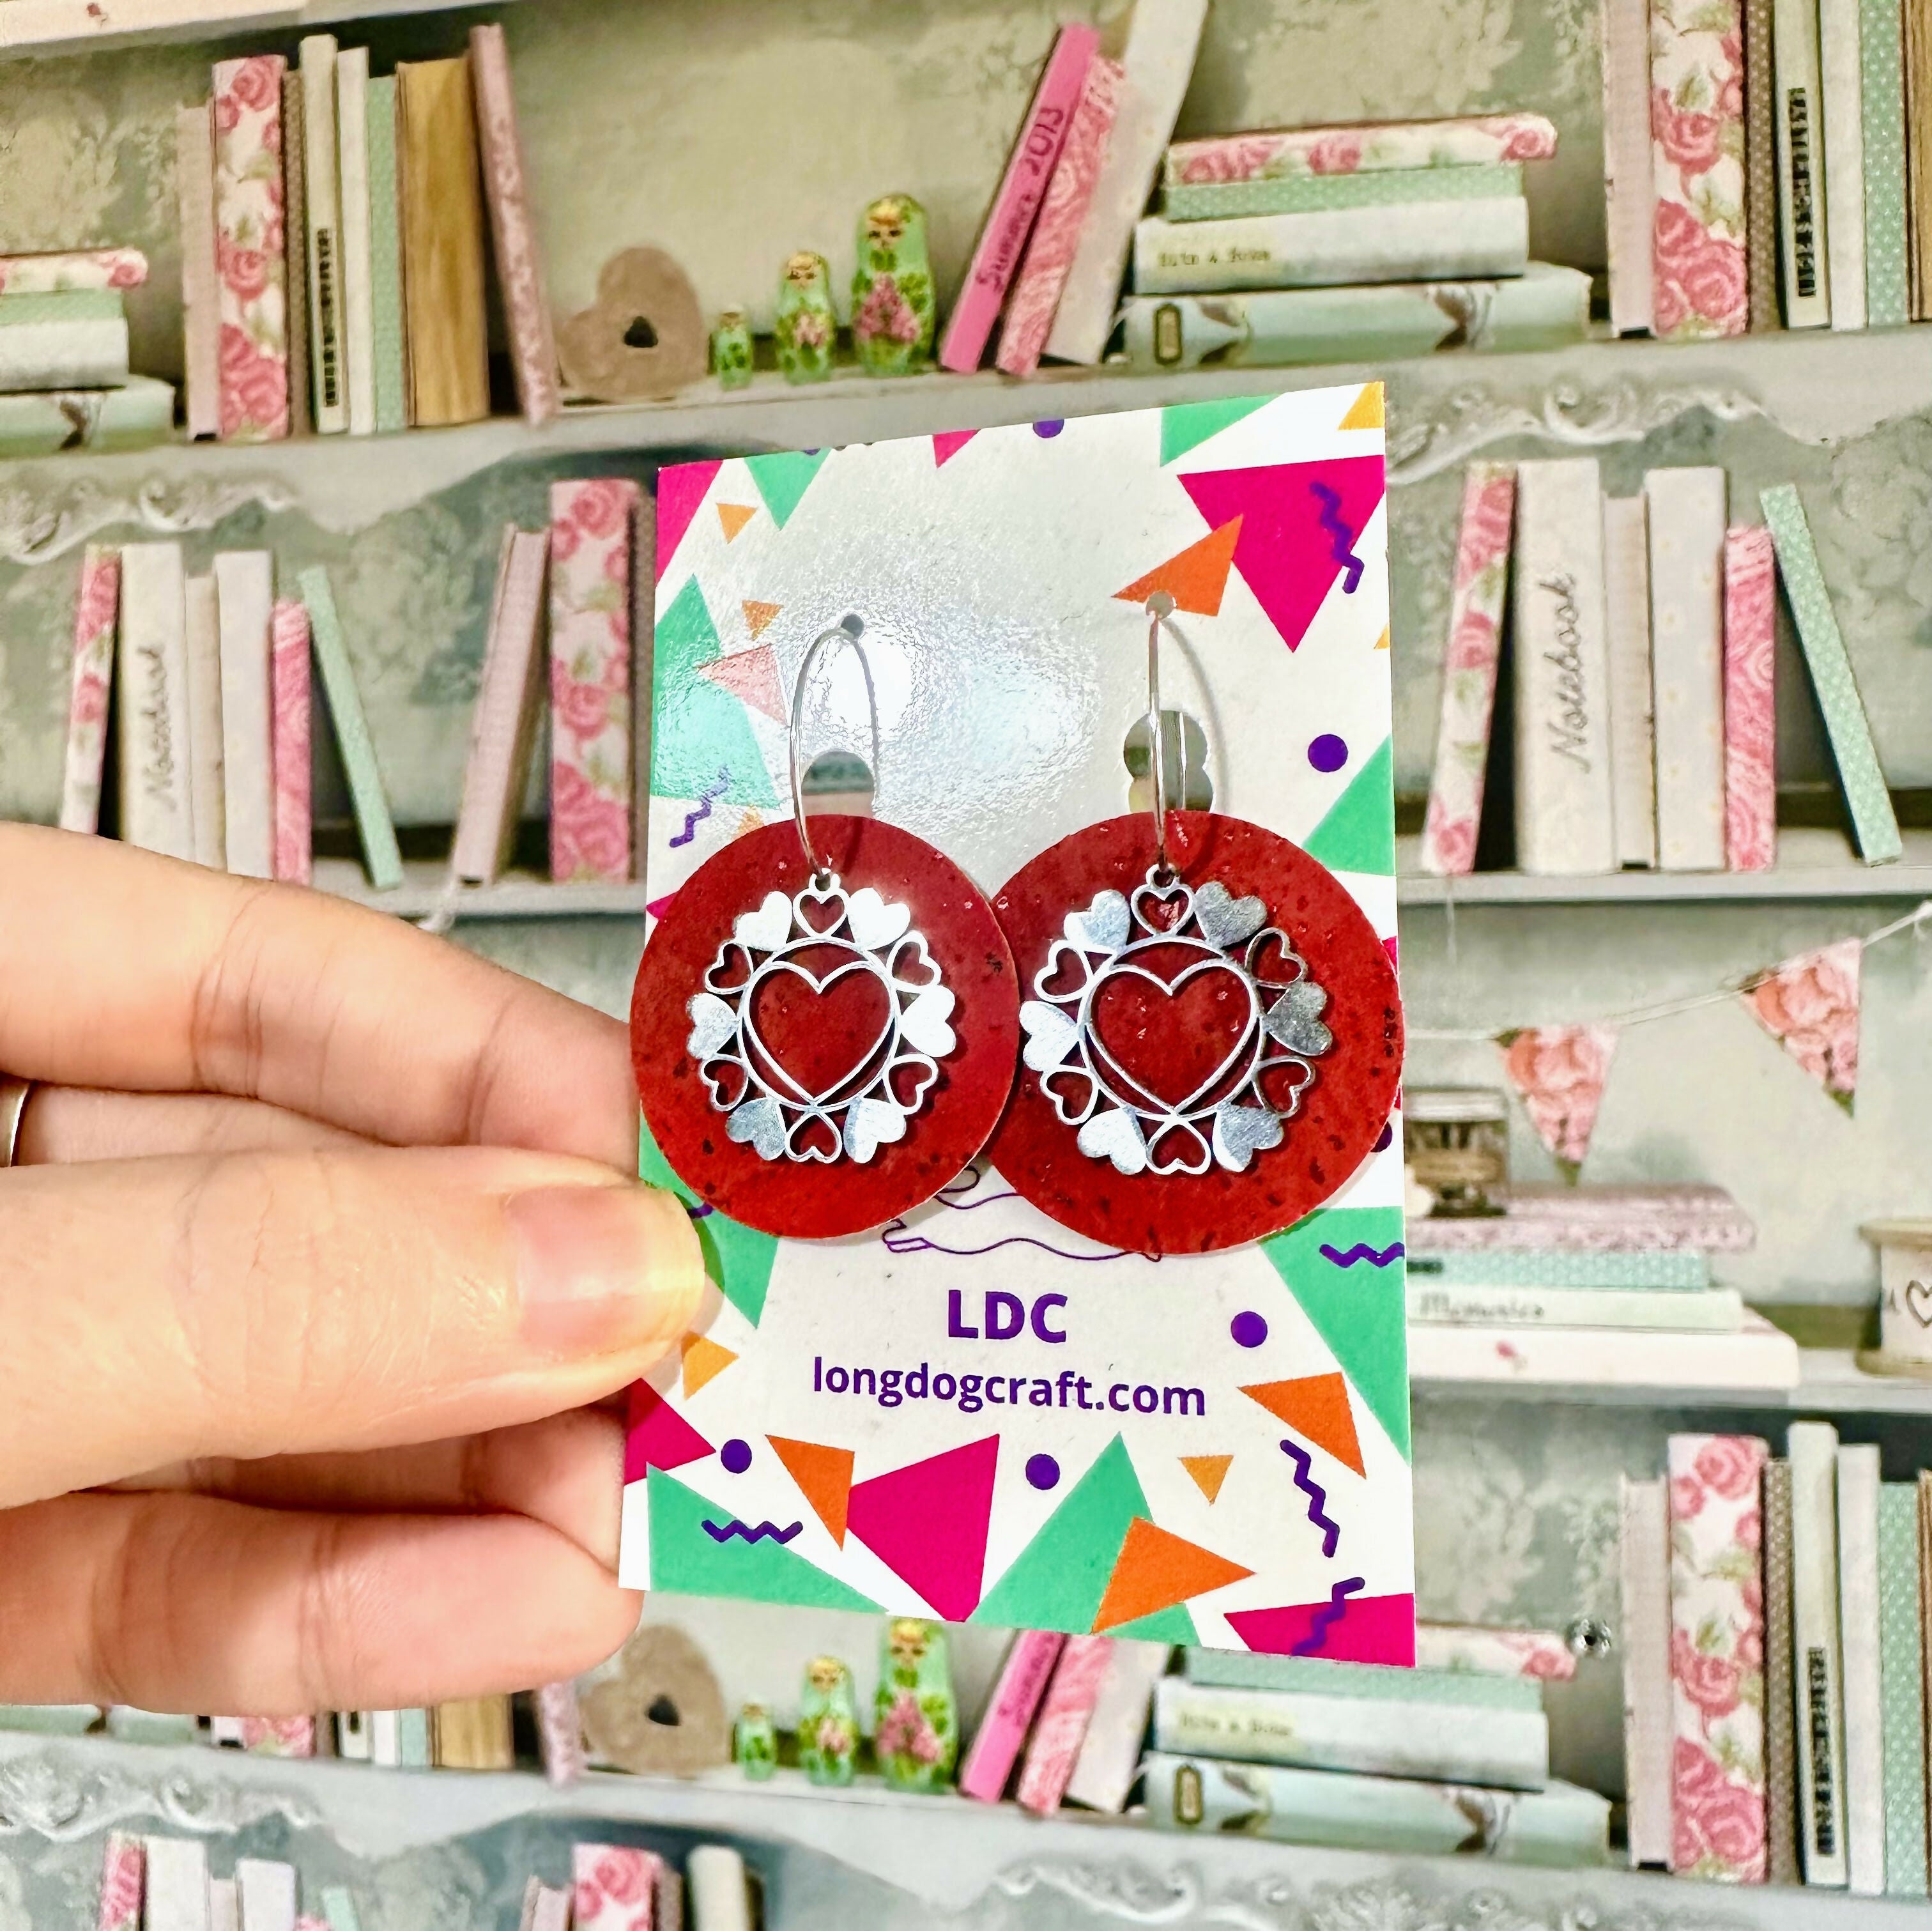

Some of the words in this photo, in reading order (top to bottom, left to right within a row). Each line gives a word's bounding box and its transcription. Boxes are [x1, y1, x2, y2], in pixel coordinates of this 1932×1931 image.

[1025, 107, 1064, 176] 2013
[1538, 573, 1592, 775] Notebook
[948, 1289, 1068, 1343] LDC
[814, 1357, 1206, 1416] longdogcraft.com
